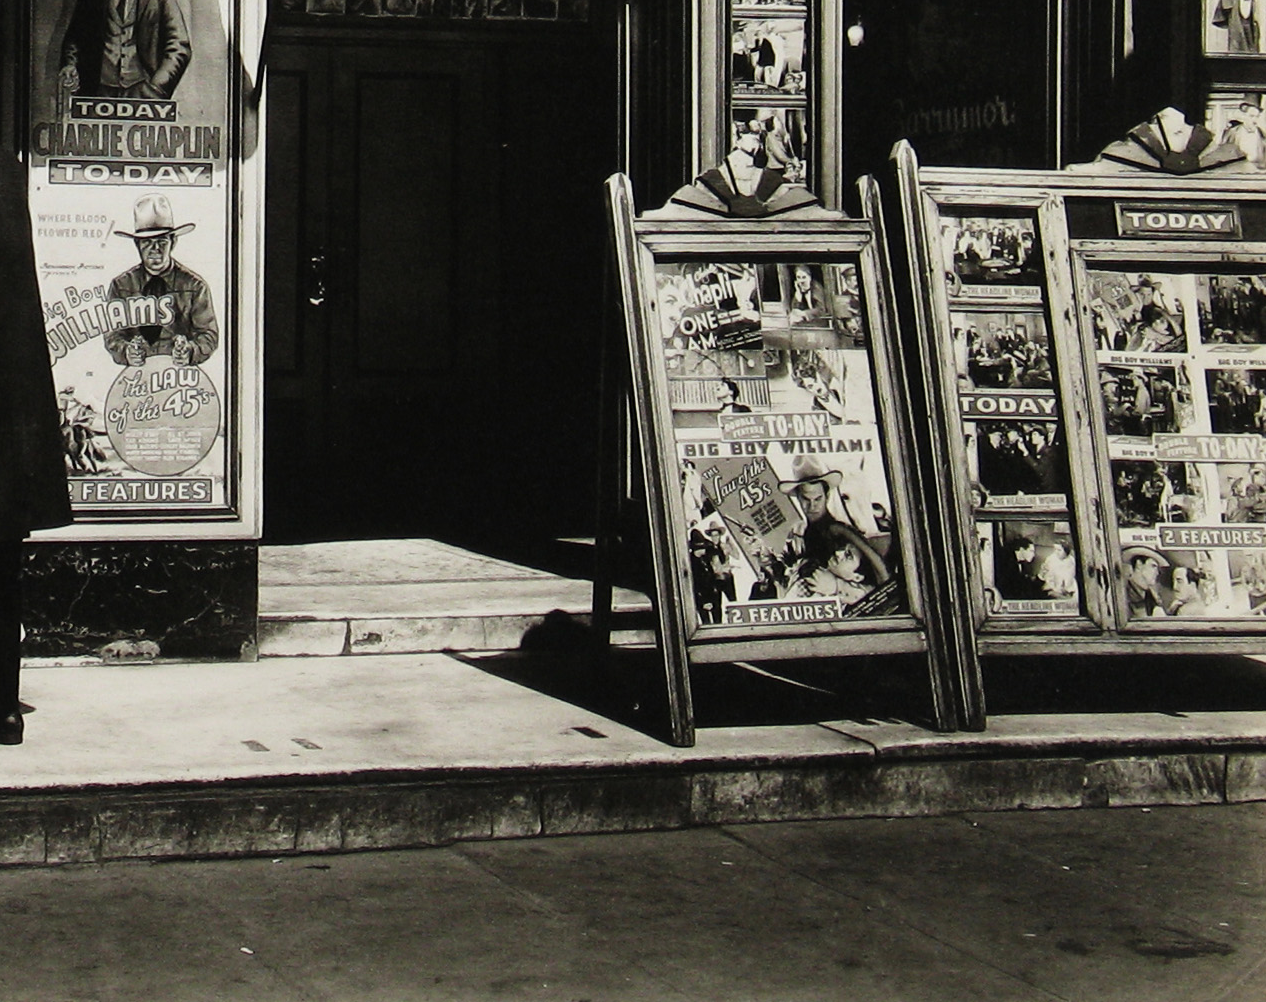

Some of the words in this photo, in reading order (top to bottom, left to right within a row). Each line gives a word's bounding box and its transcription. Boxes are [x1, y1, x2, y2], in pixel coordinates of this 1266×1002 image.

[76, 101, 174, 119] TODAY
[35, 122, 123, 158] CHARLIE
[127, 124, 221, 160] CHAPLIN
[57, 163, 206, 184] TO-DAY
[37, 213, 73, 224] WHERE
[75, 212, 107, 224] BLOOD
[1126, 212, 1229, 231] TODAY
[37, 227, 78, 239] FLOWED
[64, 285, 108, 309] Boy
[679, 310, 719, 335] ONE
[150, 367, 199, 394] LAW
[108, 401, 130, 434] of
[133, 396, 161, 421] the
[959, 396, 1057, 415] TODAY
[763, 412, 826, 438] TO-DAY
[685, 444, 719, 457] BIG
[730, 442, 770, 455] BOY
[783, 439, 873, 454] WILLIAMS
[1196, 437, 1258, 459] TO-DAY
[82, 481, 208, 501] FEATURES
[1164, 530, 1175, 543] 2
[1180, 529, 1263, 545] FEATURES
[733, 610, 744, 623] 2
[749, 605, 834, 623] FEATURES
